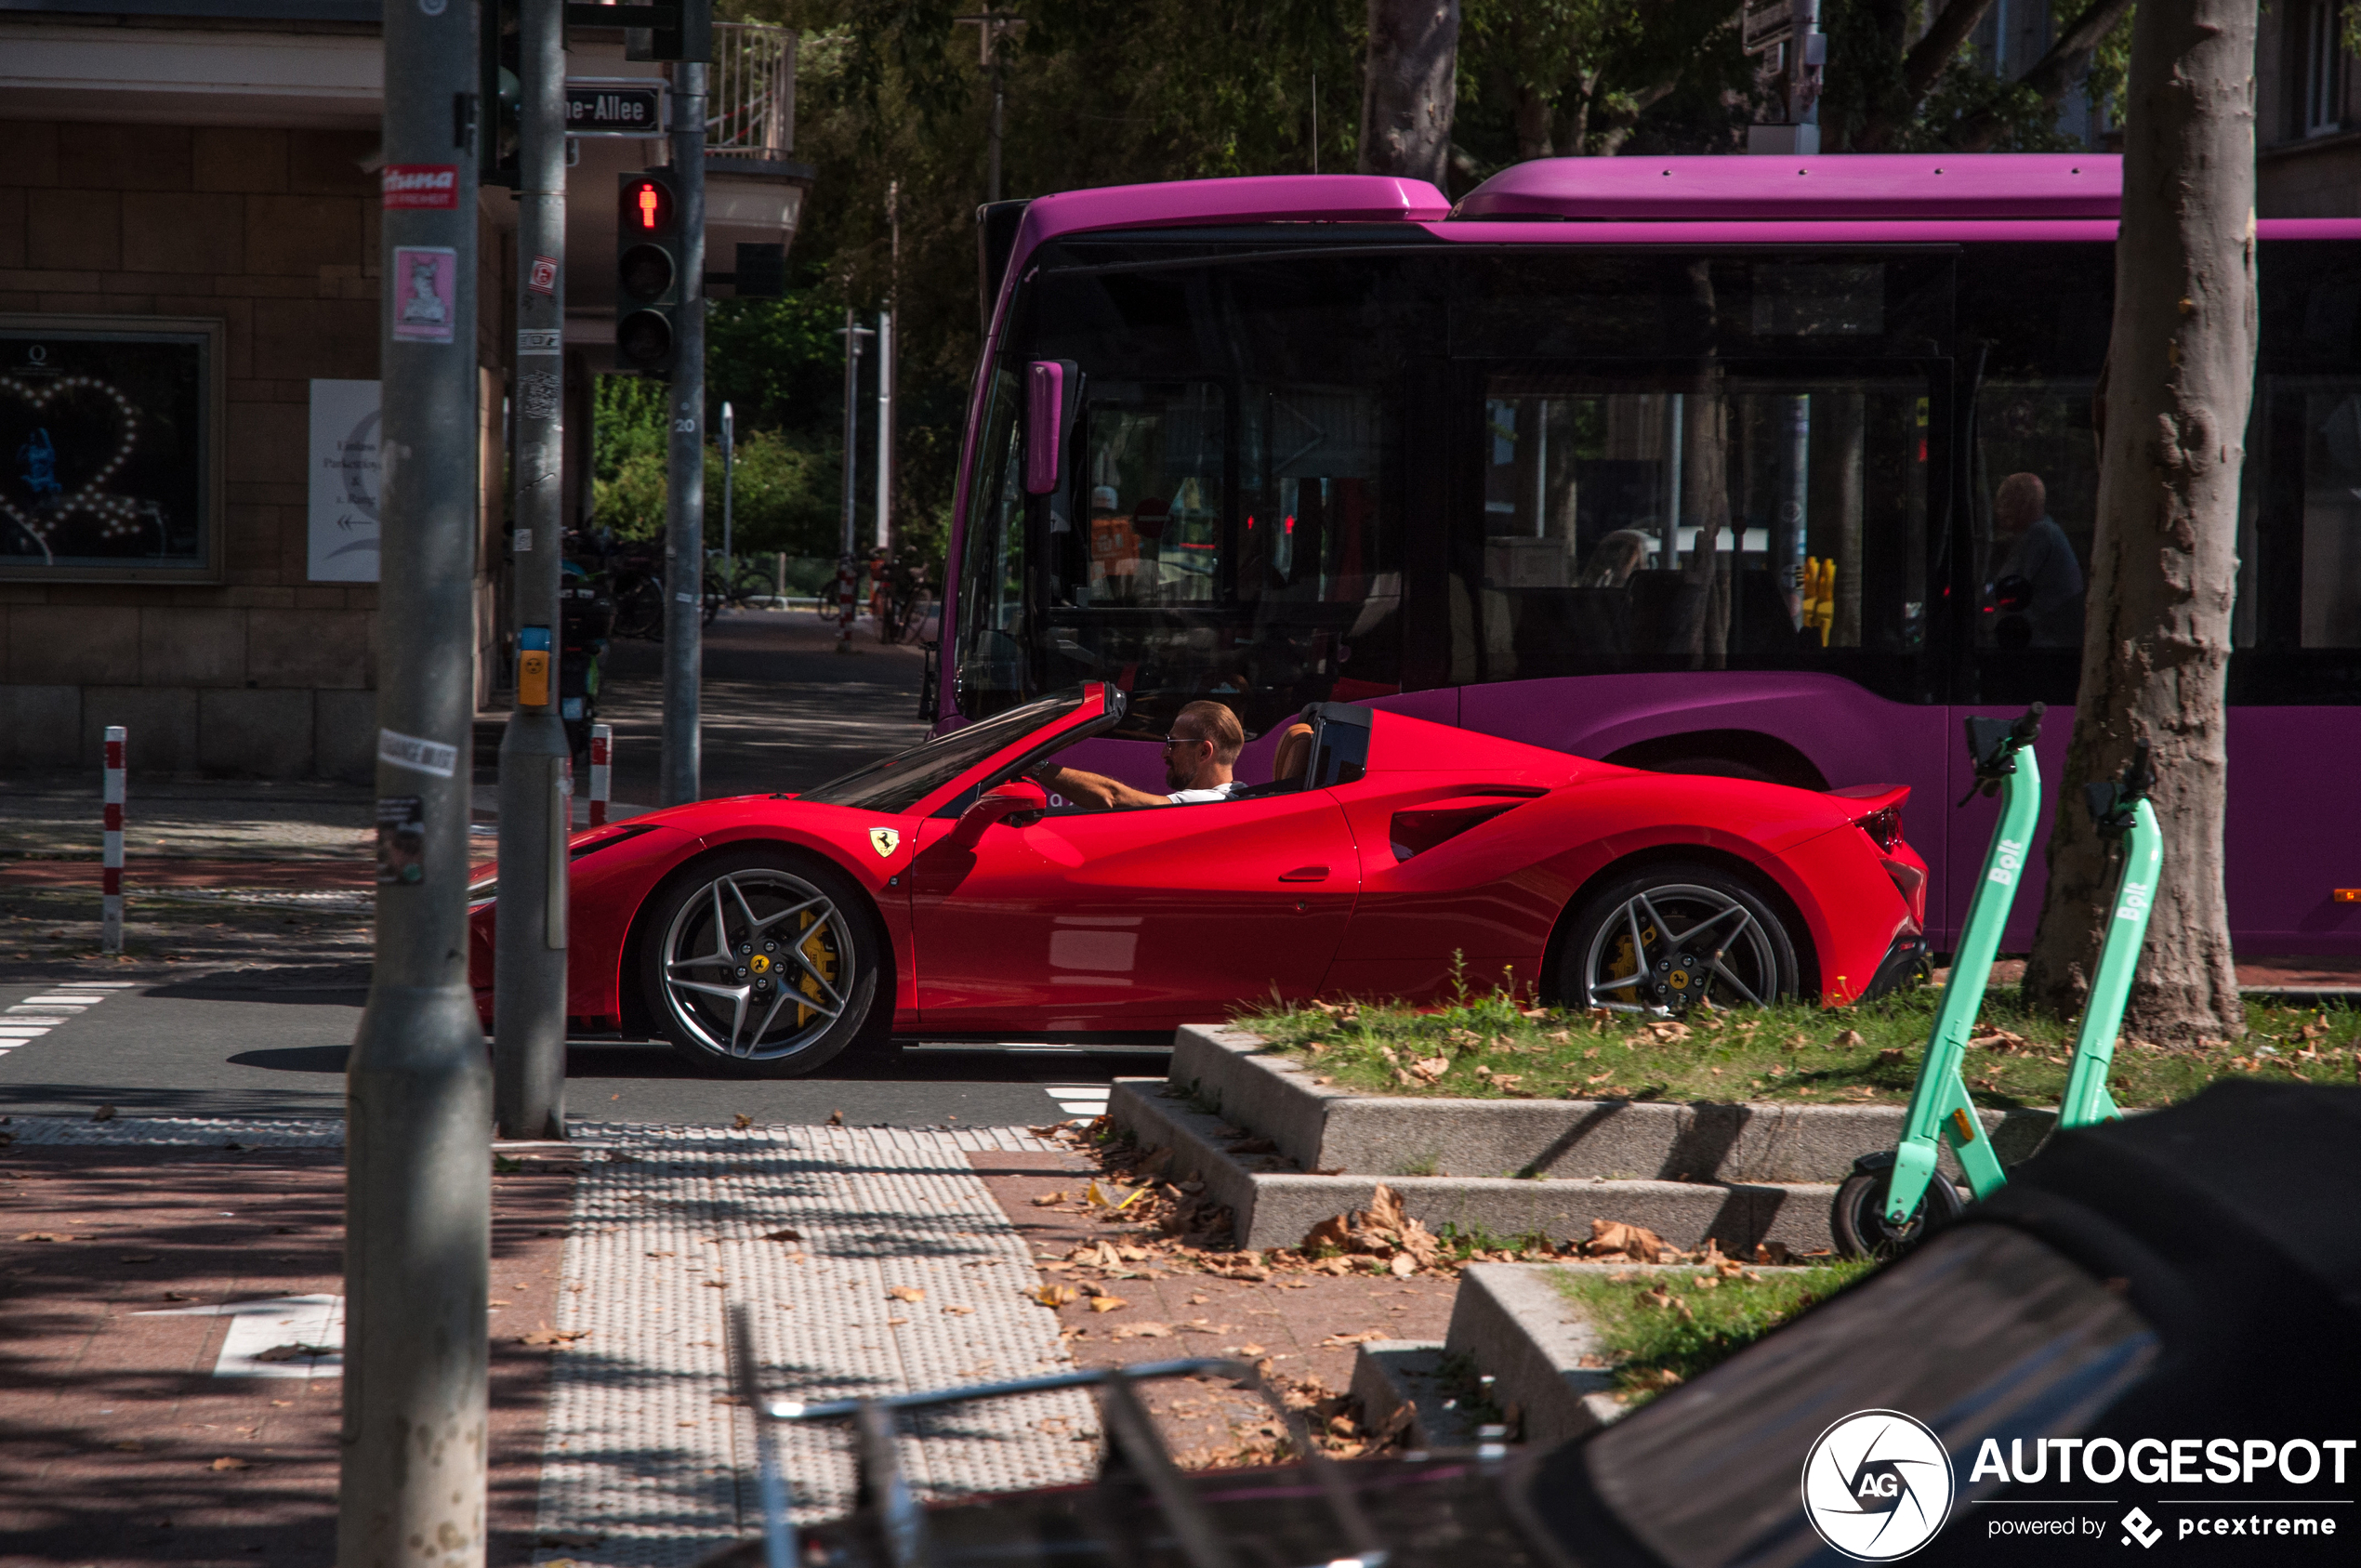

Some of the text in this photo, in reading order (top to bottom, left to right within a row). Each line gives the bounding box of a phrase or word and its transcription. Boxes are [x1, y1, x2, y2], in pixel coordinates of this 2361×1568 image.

[675, 418, 696, 433] 20
[1987, 839, 2022, 886] Bolt
[2116, 882, 2148, 921] Bolt
